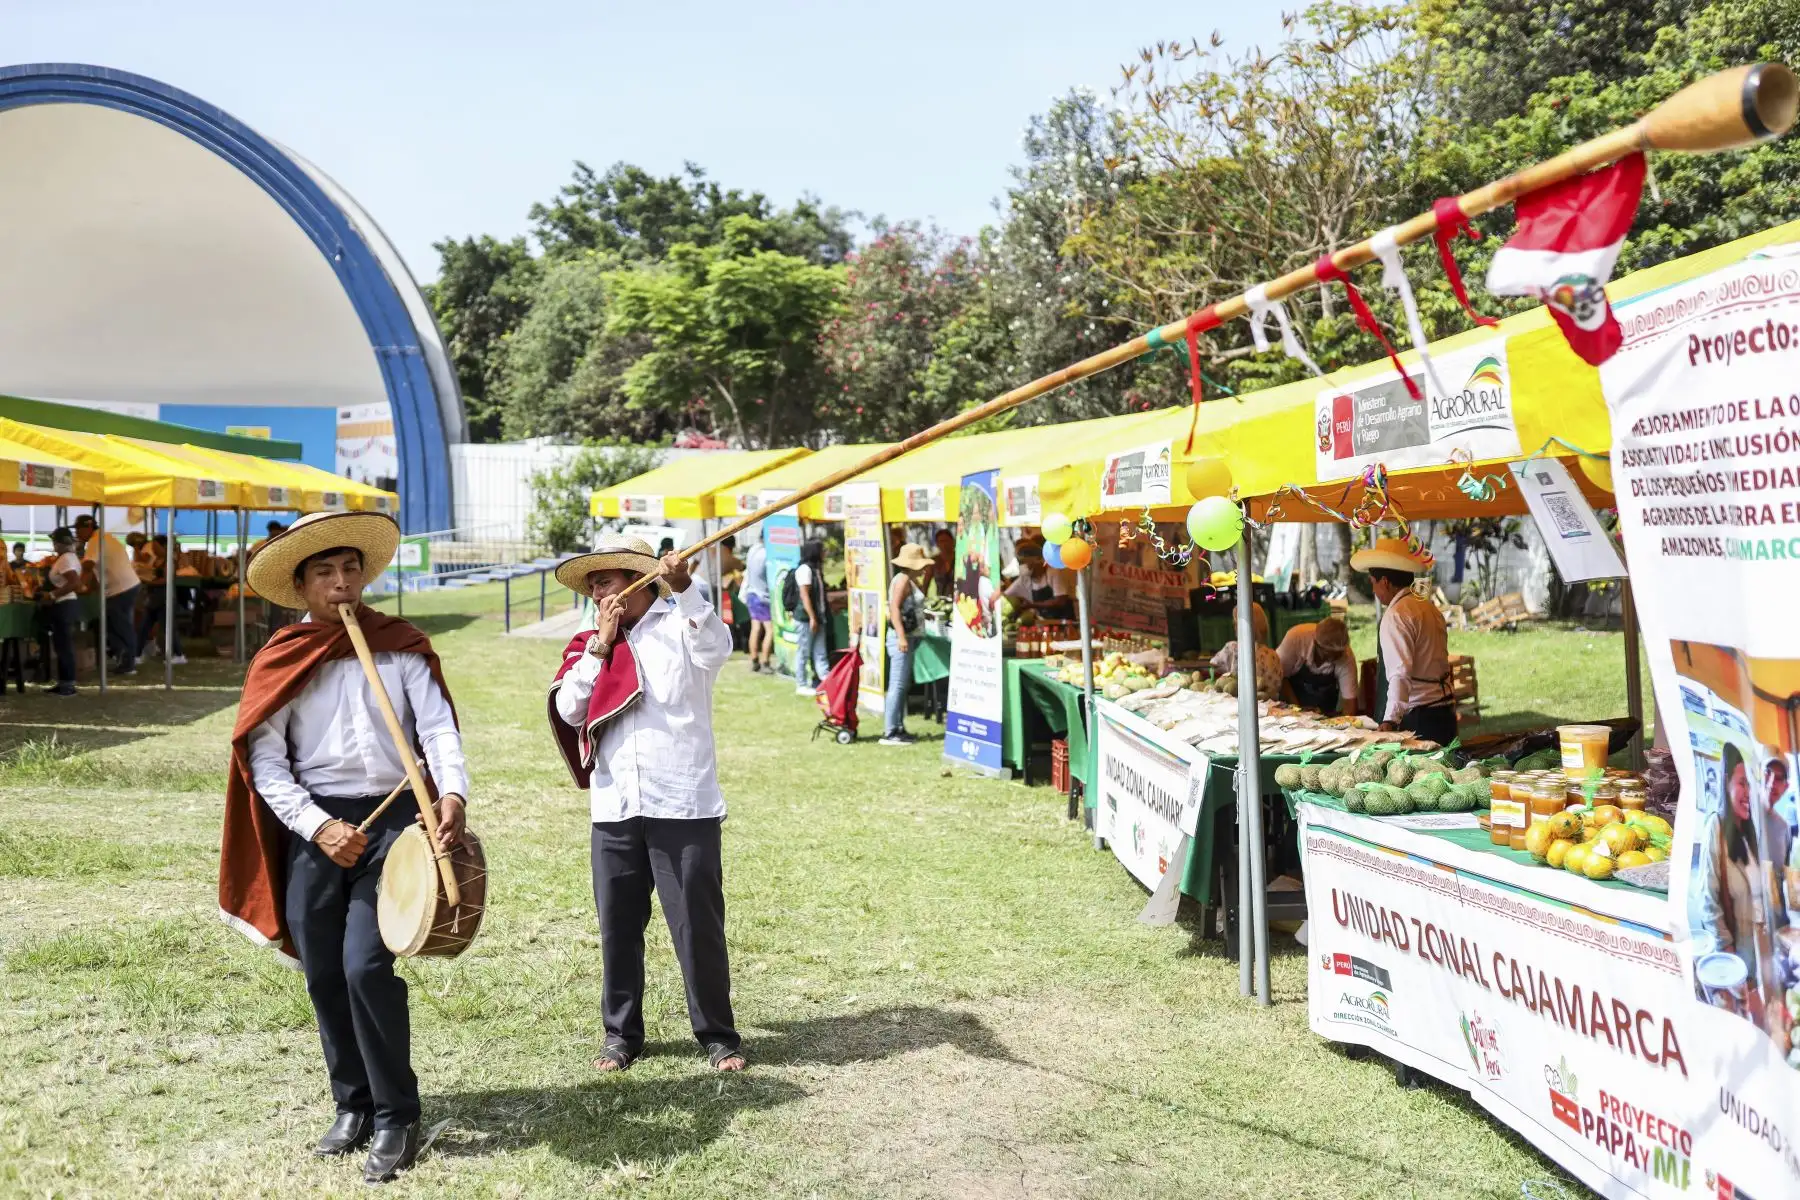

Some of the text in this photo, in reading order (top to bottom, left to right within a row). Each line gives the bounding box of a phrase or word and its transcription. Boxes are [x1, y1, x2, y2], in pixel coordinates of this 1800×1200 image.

[1688, 318, 1799, 367] Proyecto:
[1358, 394, 1386, 413] Ministerio
[1364, 406, 1397, 426] Desarrollo
[1397, 402, 1423, 421] Agrario
[1632, 403, 1725, 437] MEJORAMIENTO
[1727, 400, 1750, 423] DE
[1755, 396, 1785, 420] LA
[1336, 416, 1351, 435] PERÚ
[1361, 428, 1380, 443] Riego
[1631, 478, 1647, 498] DE
[1663, 469, 1725, 498] PEQUEÑOS
[1642, 505, 1695, 527] AGRARIOS
[1695, 505, 1712, 526] DE
[1126, 766, 1146, 805] ZONAL
[1336, 960, 1351, 970] PERÚ
[1331, 887, 1690, 1078] UNIDAD ZONAL CAJAMARCA
[1598, 1089, 1693, 1157] PROYECTO
[1719, 1086, 1782, 1153] UNIDAD
[1581, 1106, 1640, 1170] PAPA
